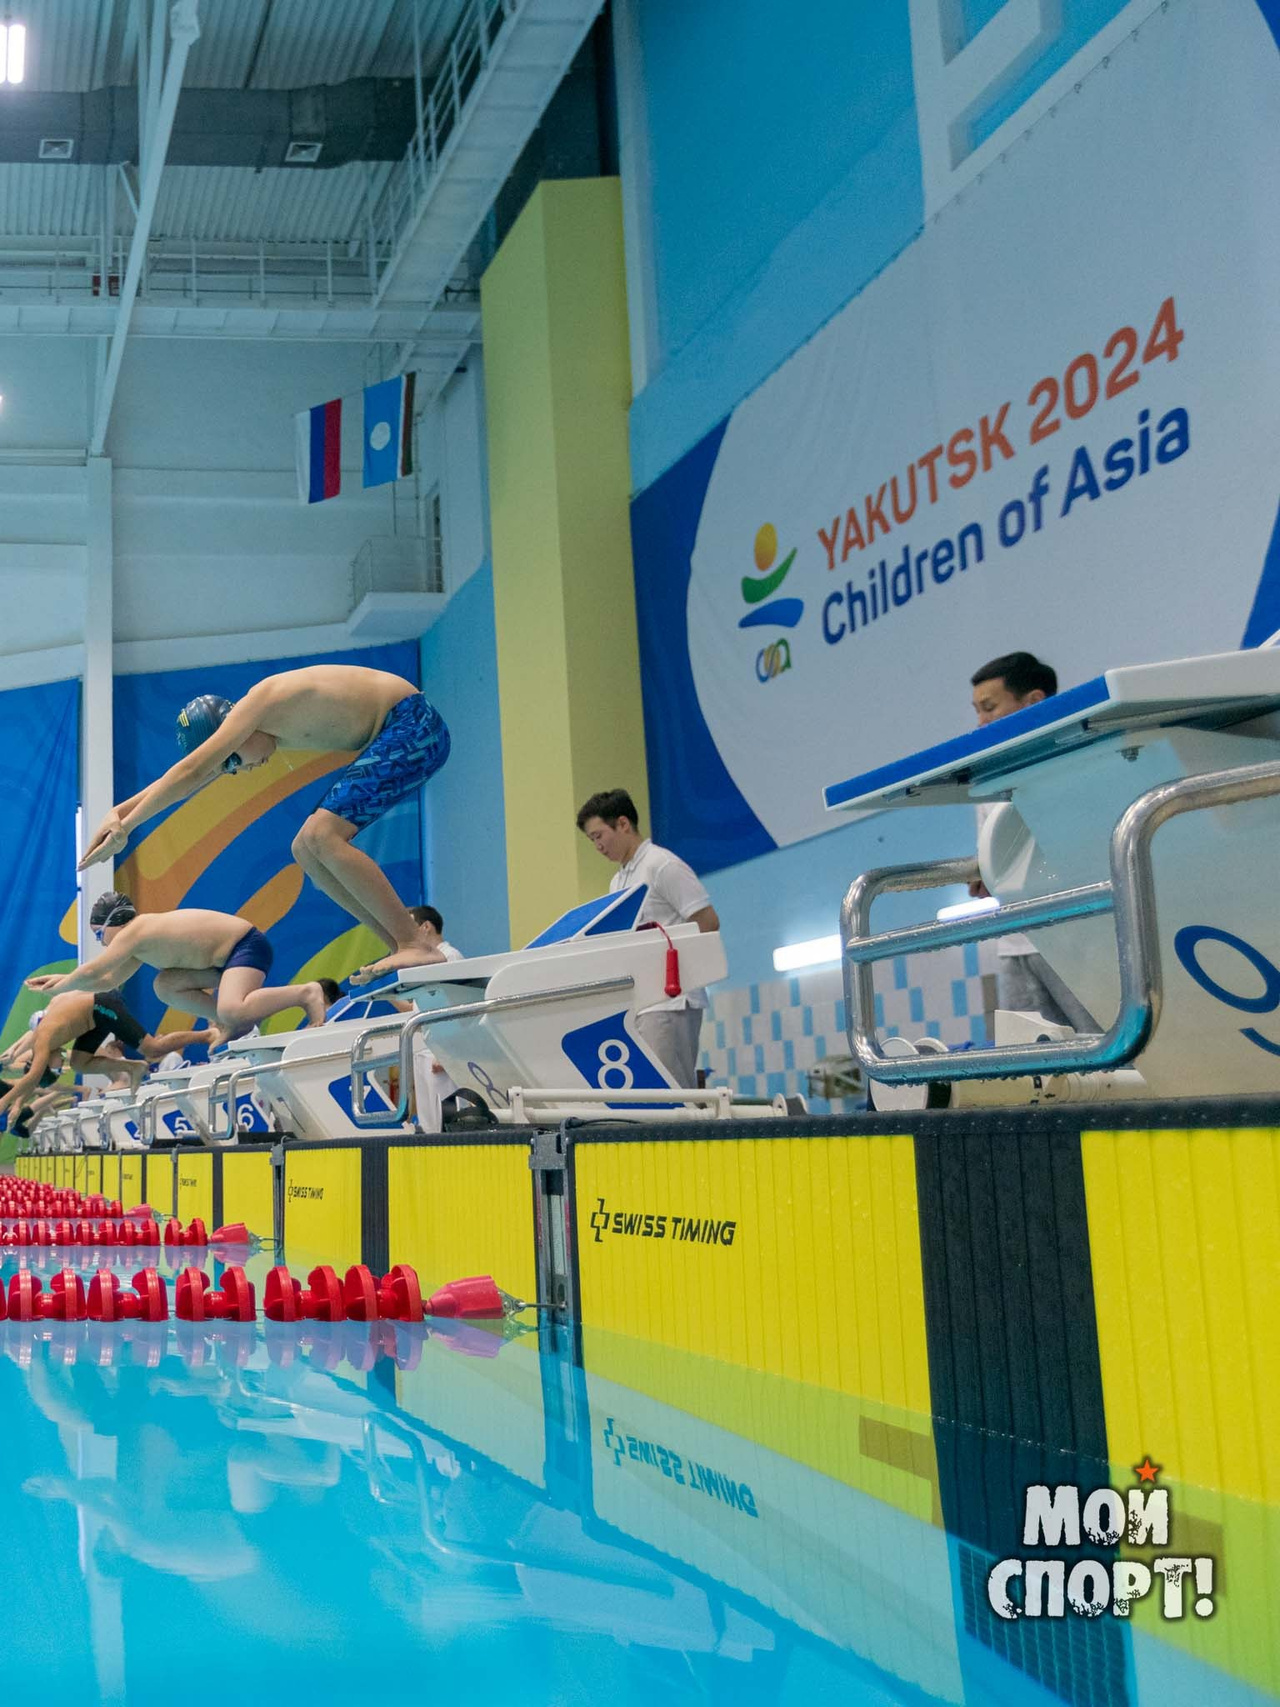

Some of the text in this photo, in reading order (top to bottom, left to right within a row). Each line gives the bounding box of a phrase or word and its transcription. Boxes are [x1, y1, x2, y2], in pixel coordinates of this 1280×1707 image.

[817, 296, 1185, 571] YAKUTSK 2024
[822, 406, 1191, 646] Children of Asia
[597, 1039, 634, 1090] 8
[174, 1117, 188, 1133] 5
[237, 1103, 255, 1132] 6
[612, 1212, 737, 1246] SWISS TIMING
